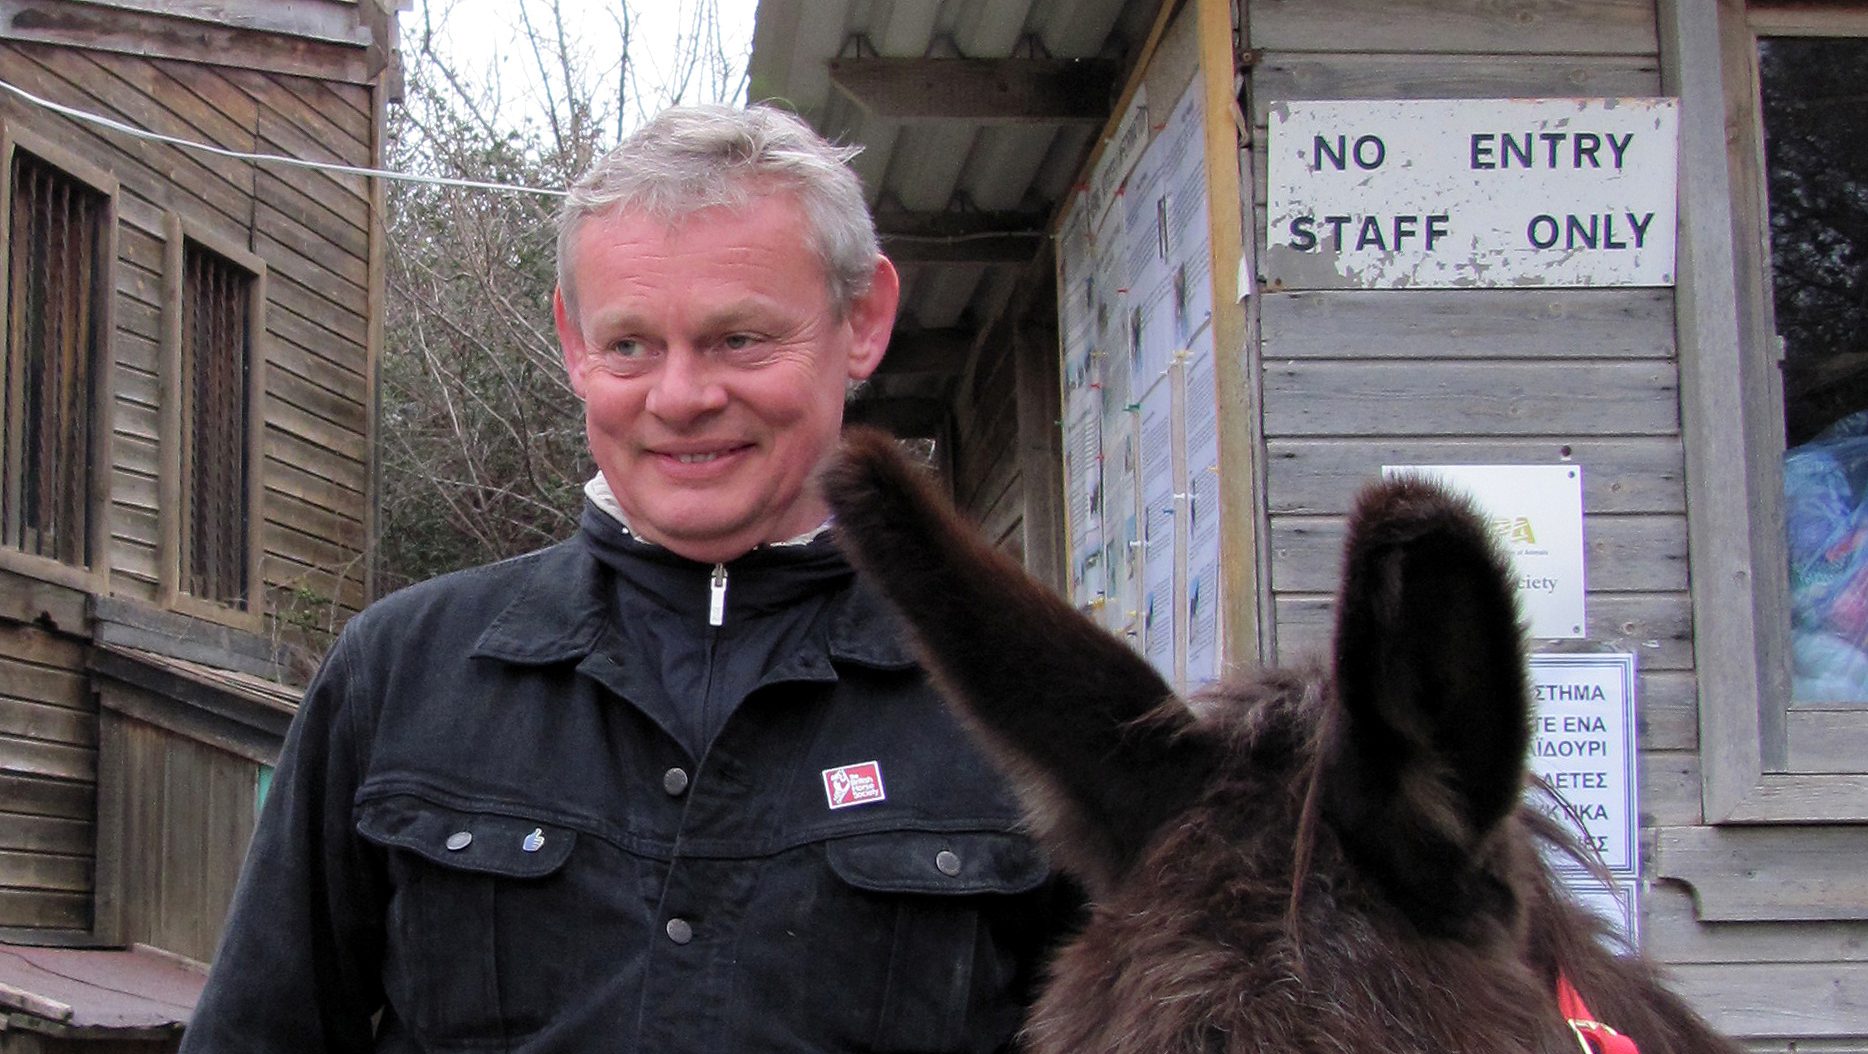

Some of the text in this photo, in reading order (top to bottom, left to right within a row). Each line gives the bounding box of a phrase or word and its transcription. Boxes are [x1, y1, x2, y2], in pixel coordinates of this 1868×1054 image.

[1313, 132, 1634, 170] NO ENTRY
[1289, 212, 1655, 252] STAFF ONLY
[1518, 574, 1559, 594] ciety
[1534, 684, 1606, 701] ΣΤΗΜΑ
[1564, 716, 1607, 733] ΕΝΑ
[1531, 737, 1607, 757] ΪΔΟΥΡΙ
[1543, 772, 1608, 789] ΛΕΤΕΣ
